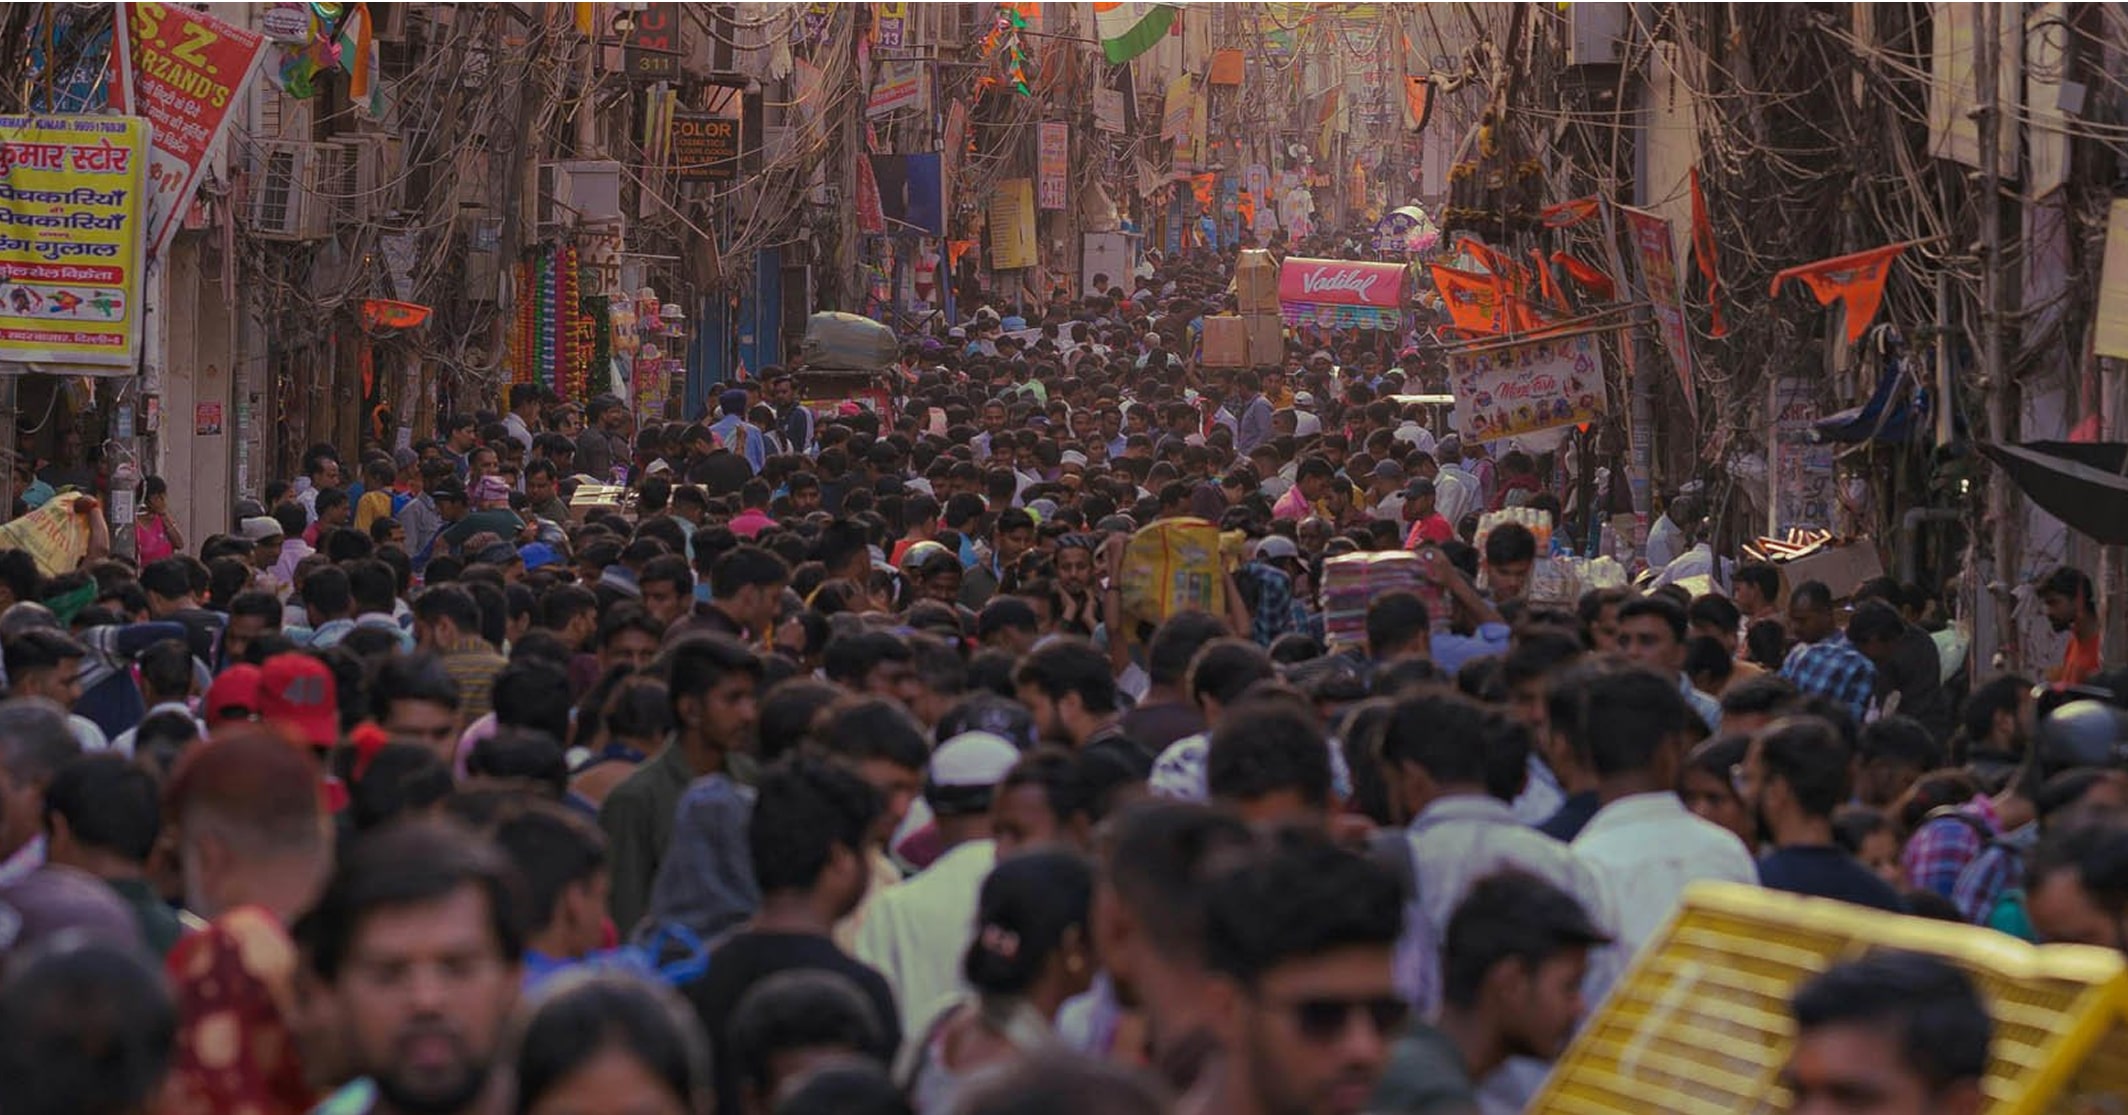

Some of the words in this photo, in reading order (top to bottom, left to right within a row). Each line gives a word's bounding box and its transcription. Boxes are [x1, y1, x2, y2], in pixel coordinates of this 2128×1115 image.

[171, 20, 218, 75] Z.
[640, 57, 669, 71] 311
[131, 37, 230, 109] RZAND'S
[72, 138, 131, 172] स्टोर
[35, 241, 120, 260] गुलाल
[1302, 266, 1379, 302] Vadilal
